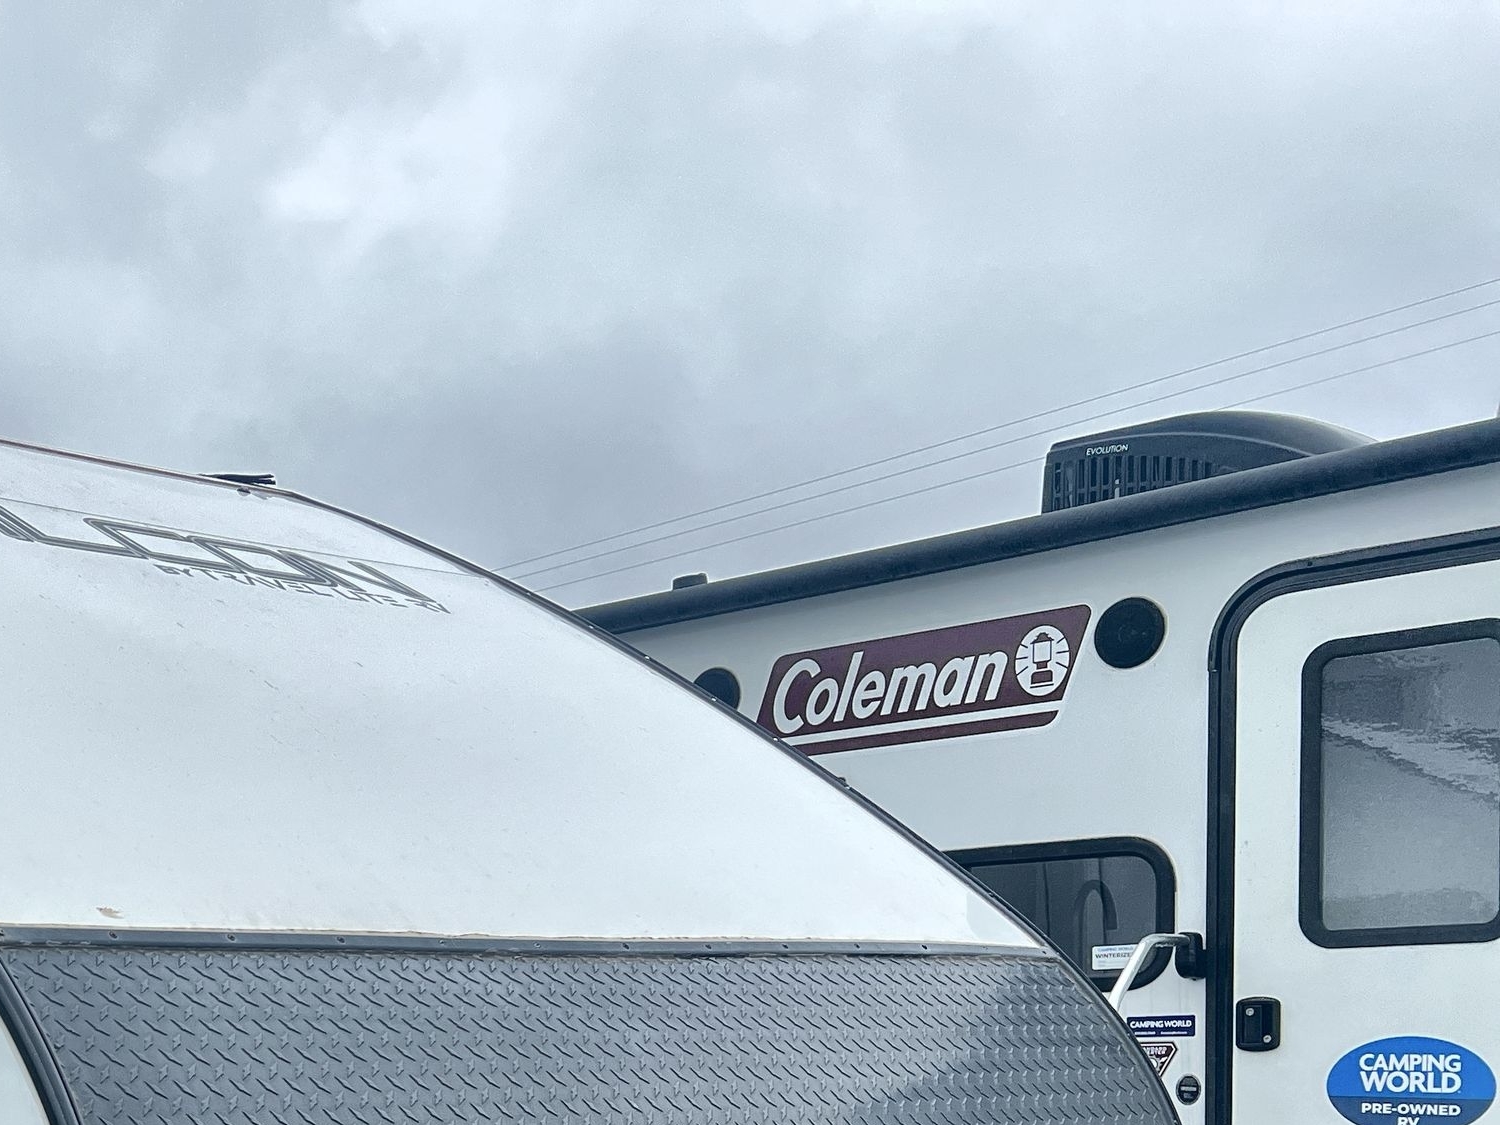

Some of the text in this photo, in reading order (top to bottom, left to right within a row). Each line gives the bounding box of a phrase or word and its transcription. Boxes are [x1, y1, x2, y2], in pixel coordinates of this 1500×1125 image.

[1086, 444, 1129, 456] EVOLUTION
[153, 564, 194, 577] BY
[772, 650, 1009, 734] Coleman
[1130, 1020, 1192, 1029] CAMPING WORLD
[1359, 1053, 1462, 1073] CAMPING
[1360, 1071, 1462, 1093] WORLD
[1361, 1102, 1461, 1116] PRE-OWNED
